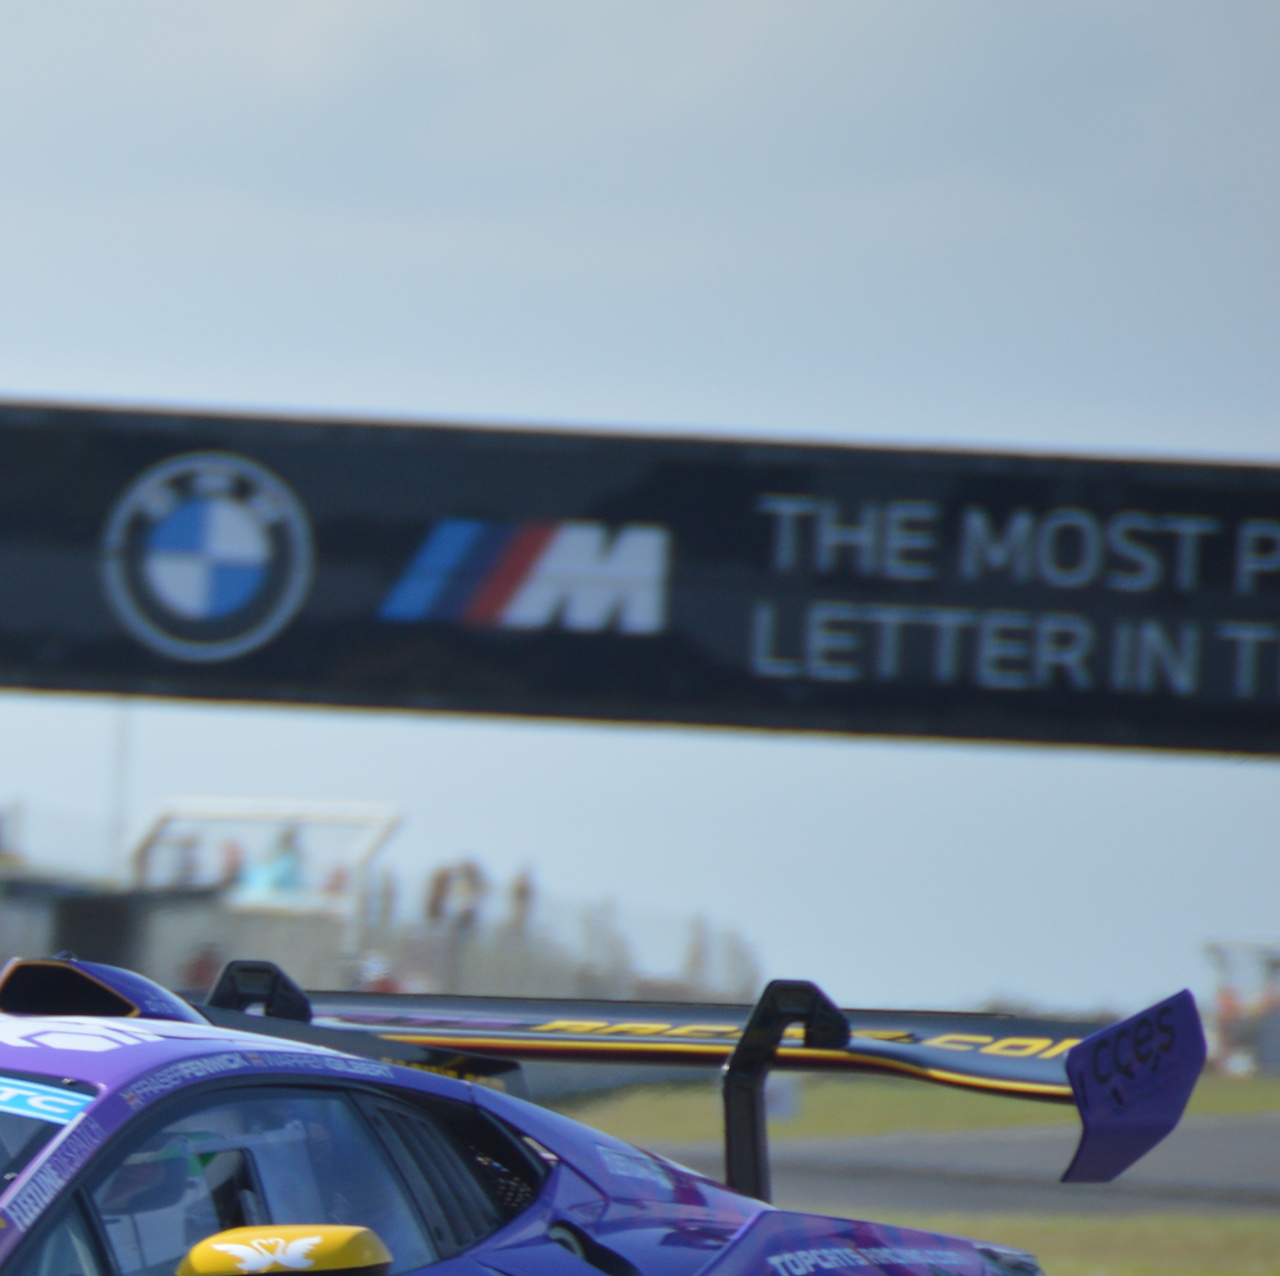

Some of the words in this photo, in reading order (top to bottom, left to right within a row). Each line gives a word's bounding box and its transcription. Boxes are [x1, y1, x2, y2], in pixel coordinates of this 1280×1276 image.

[757, 495, 939, 581] THE
[960, 505, 1221, 593] MOST
[753, 603, 1097, 690] LETTER
[1110, 618, 1200, 697] IN
